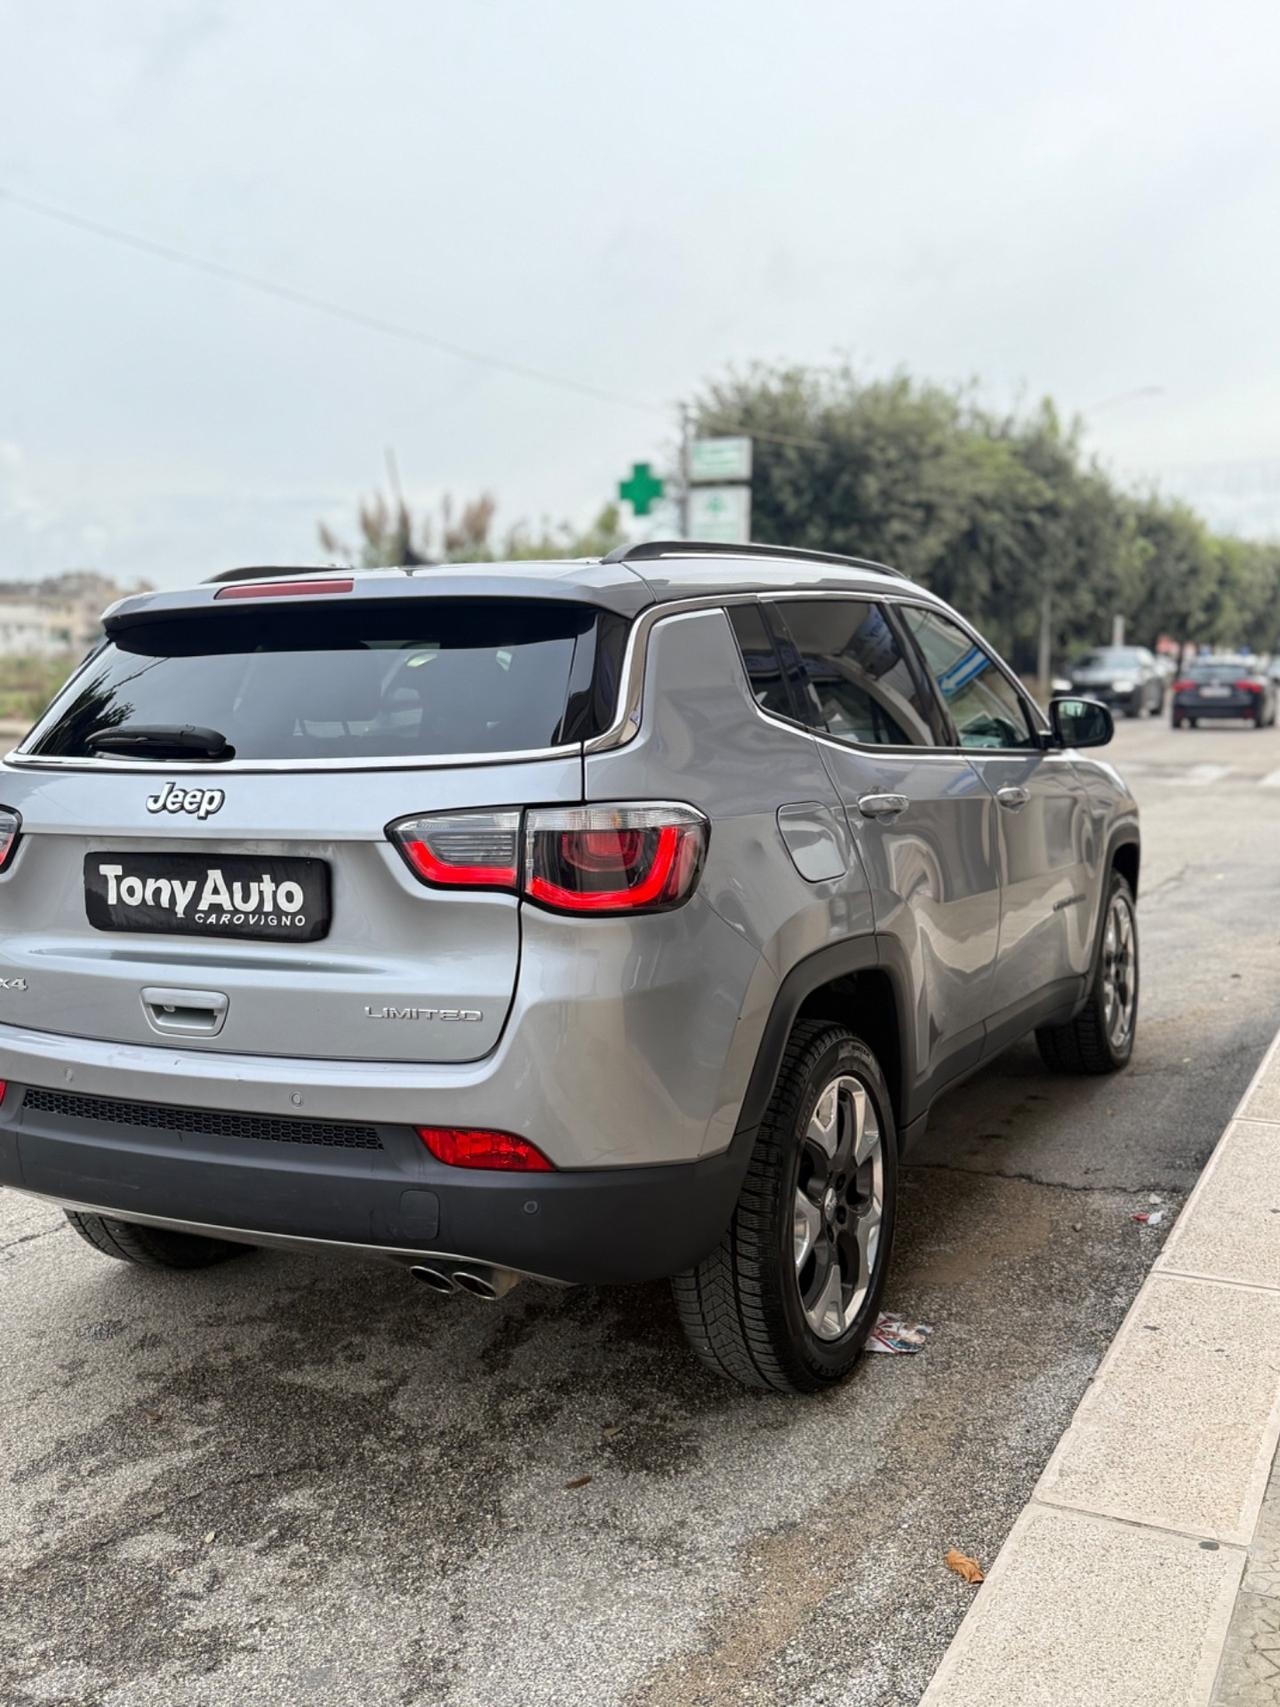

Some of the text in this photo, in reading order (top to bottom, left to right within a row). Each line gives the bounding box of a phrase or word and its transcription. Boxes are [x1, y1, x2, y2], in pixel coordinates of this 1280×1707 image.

[145, 781, 226, 820] Jeep
[98, 864, 304, 918] Tony Auto
[194, 912, 306, 927] CAROVIGNO
[364, 1006, 483, 1021] LIMITED
